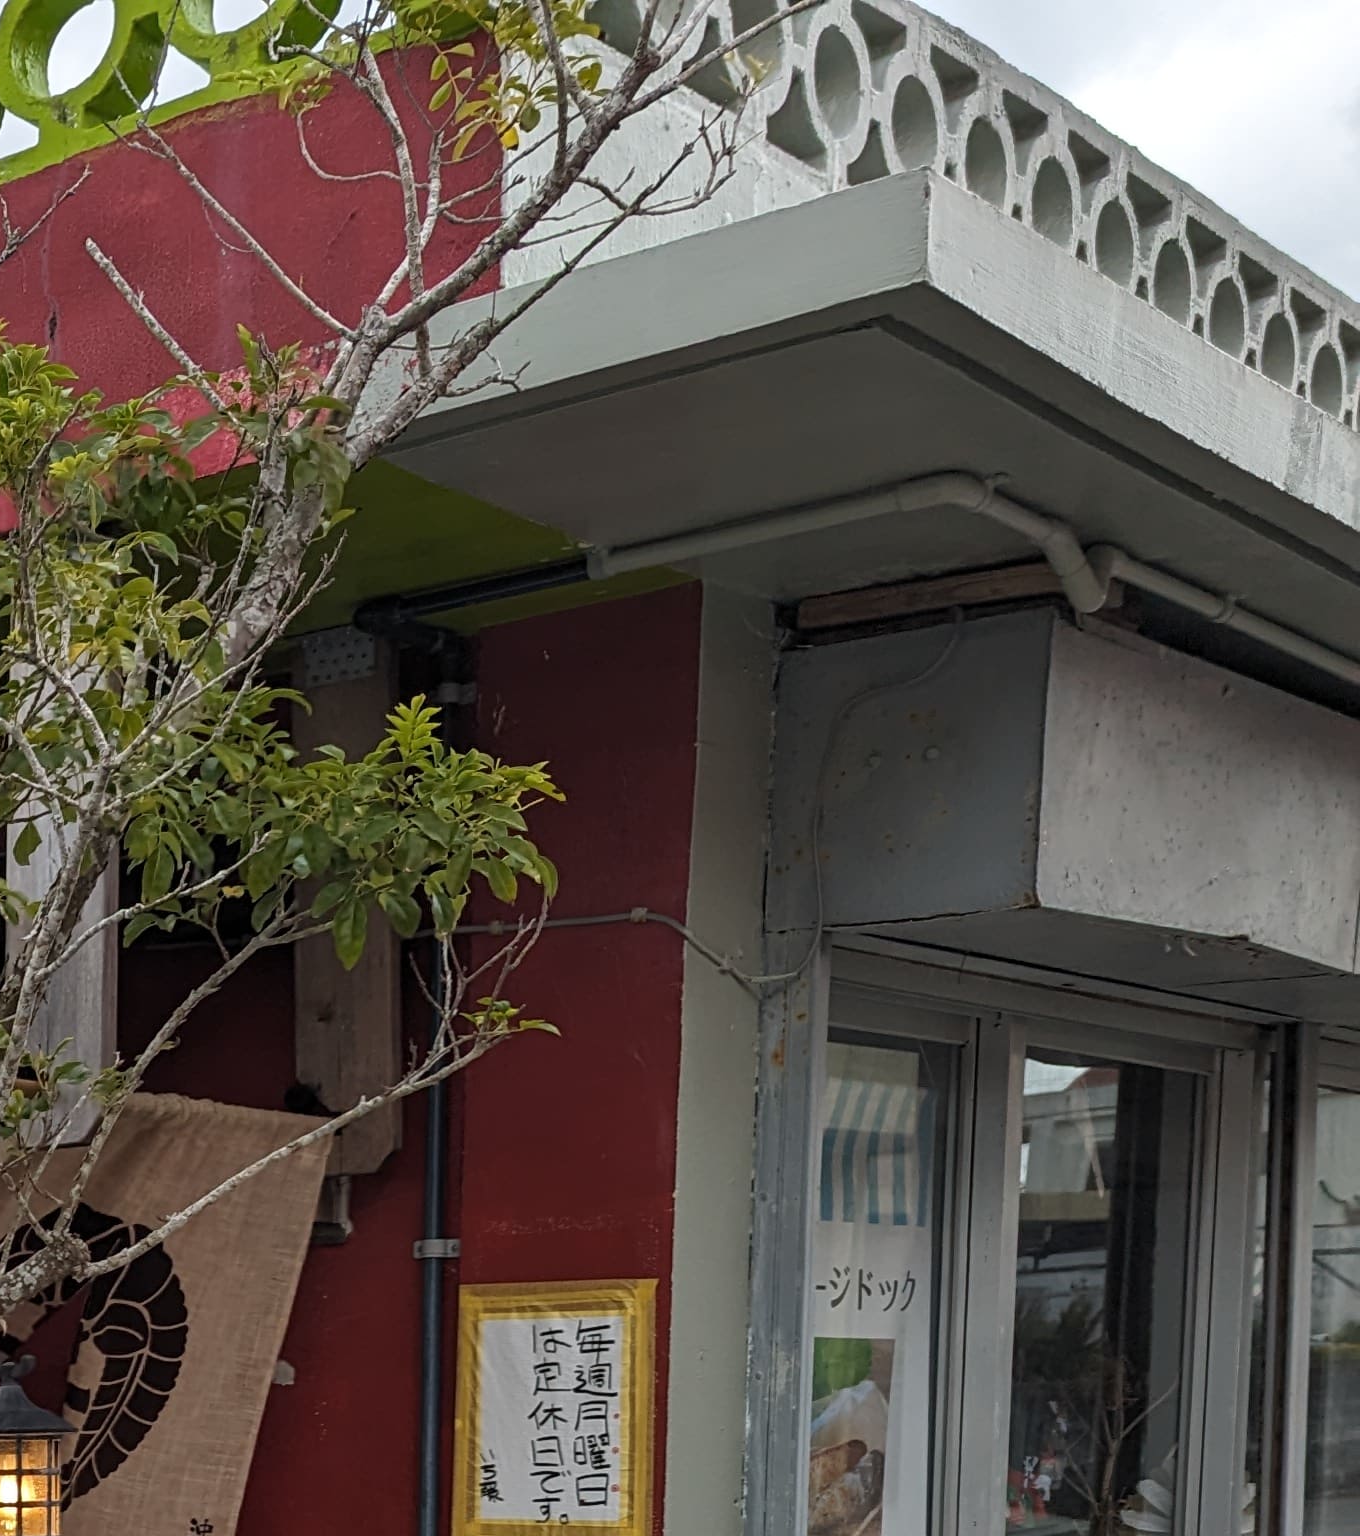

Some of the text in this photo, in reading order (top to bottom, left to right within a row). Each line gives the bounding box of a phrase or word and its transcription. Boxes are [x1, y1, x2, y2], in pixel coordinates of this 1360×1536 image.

[527, 1323, 574, 1525] は定休日です。
[572, 1319, 619, 1507] 毎週月曜日
